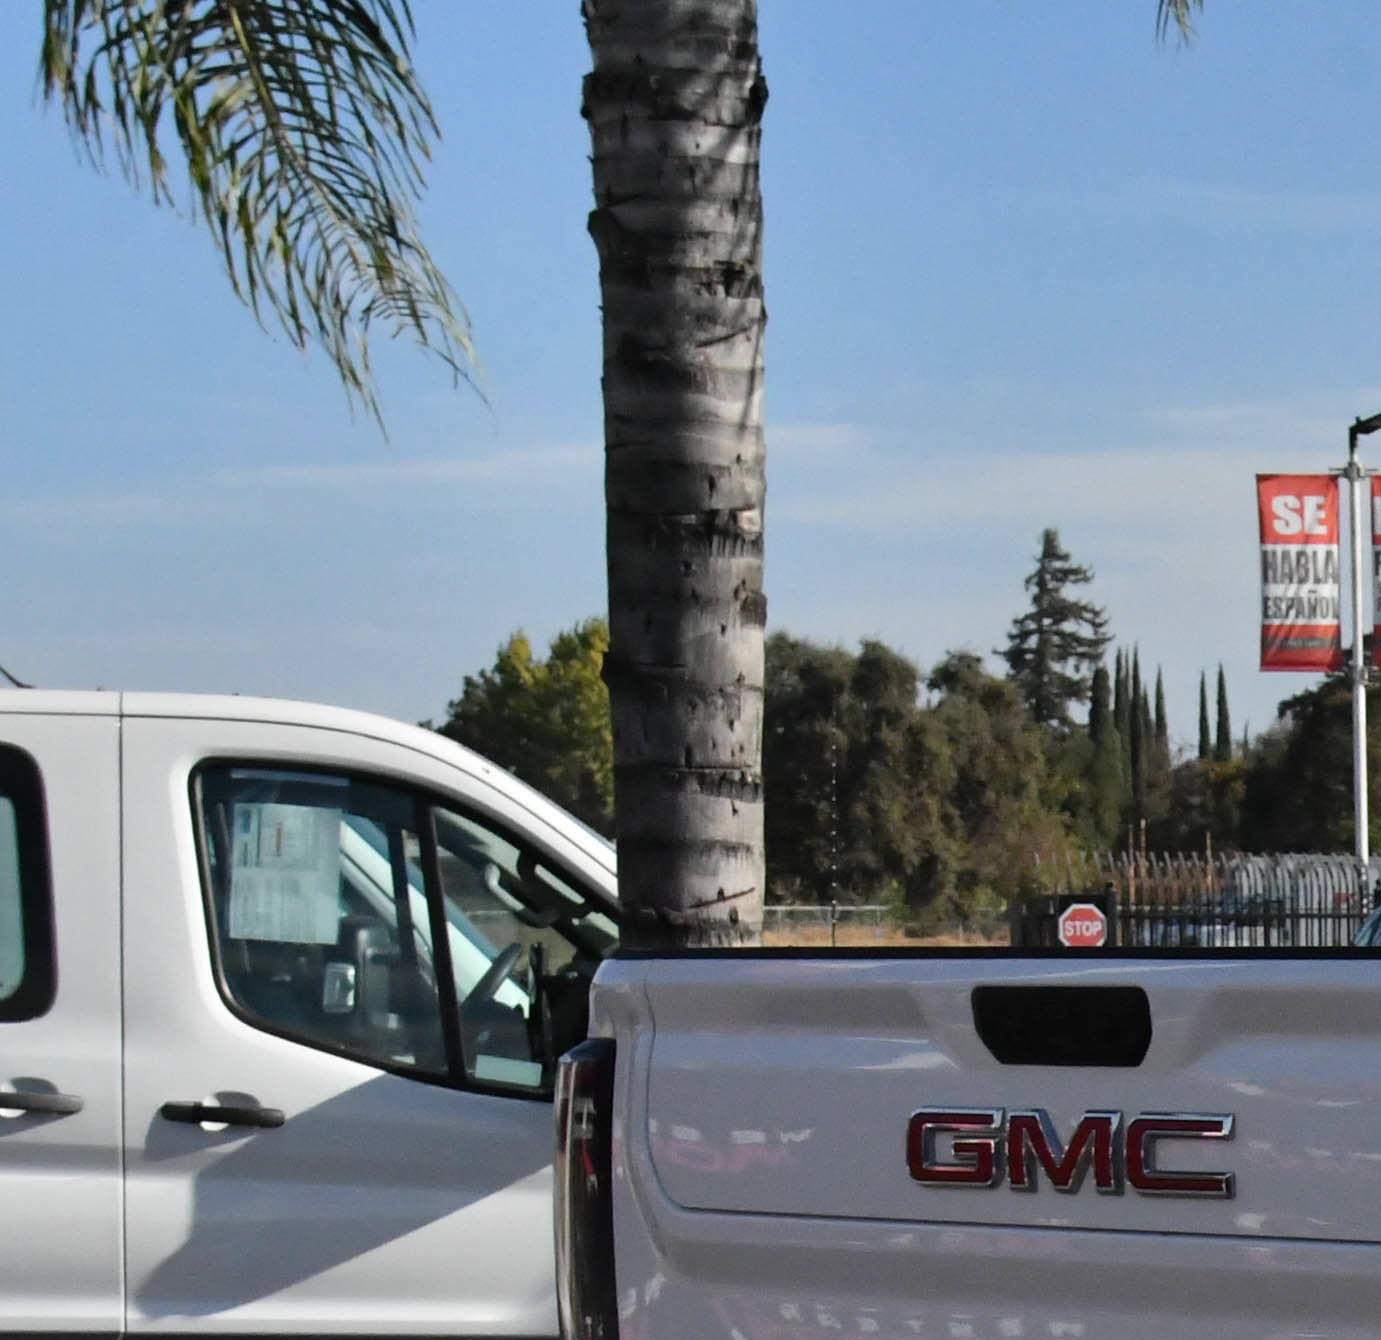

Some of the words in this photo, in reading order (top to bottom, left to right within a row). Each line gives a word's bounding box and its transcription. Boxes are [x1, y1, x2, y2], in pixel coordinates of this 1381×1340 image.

[1271, 495, 1328, 535] SE
[1263, 550, 1338, 584] HABLA
[1065, 920, 1102, 936] STOP
[906, 1106, 1236, 1199] GMC
